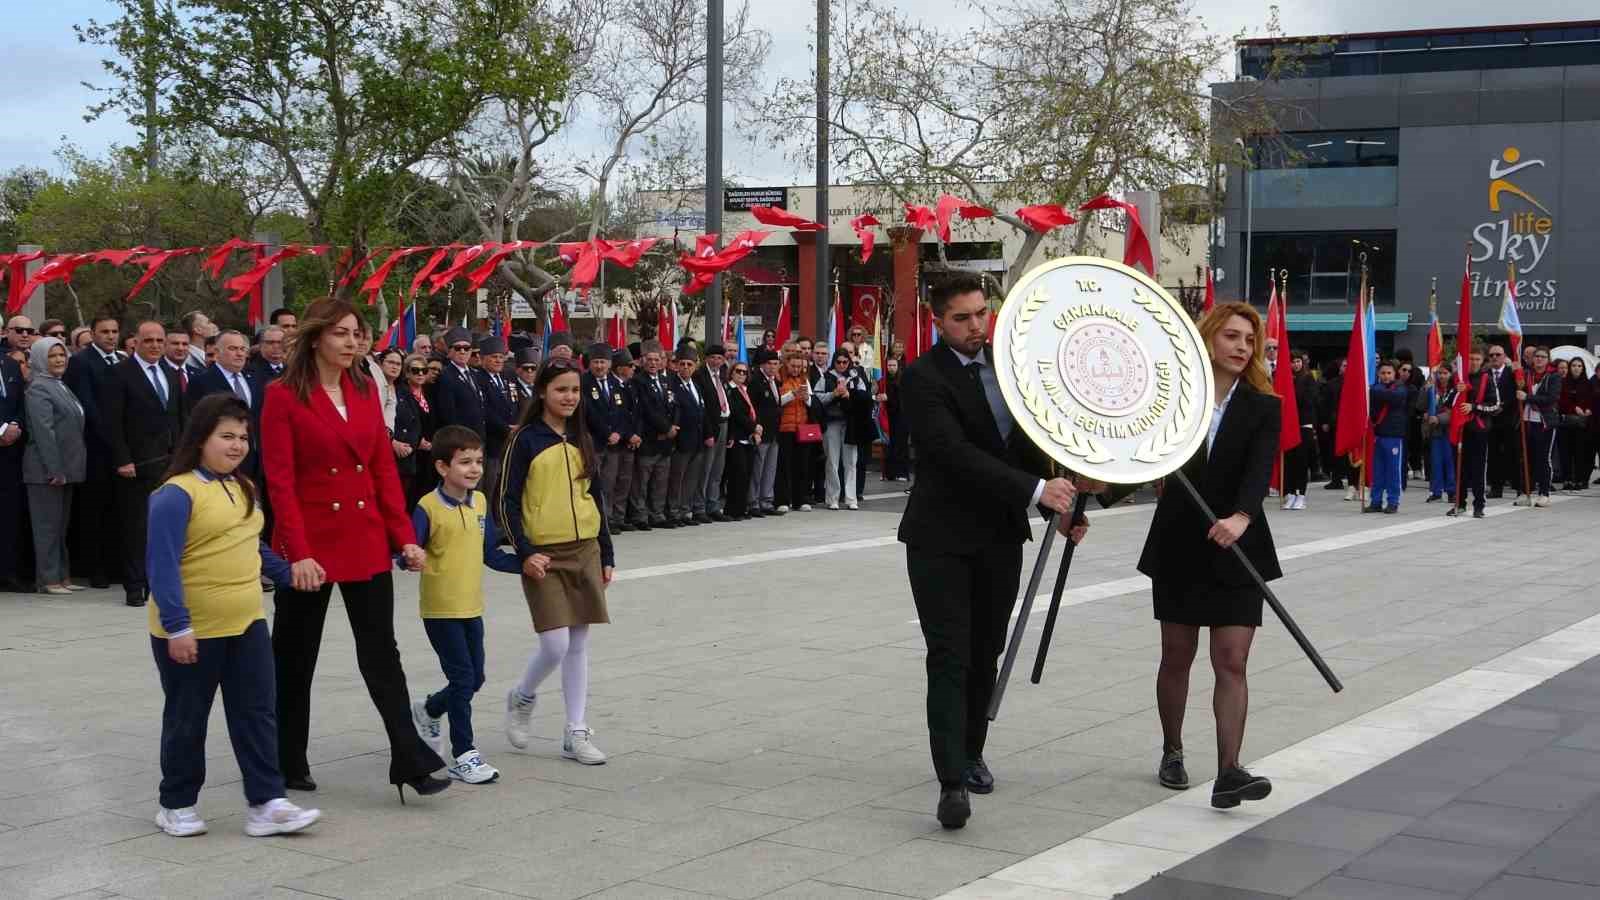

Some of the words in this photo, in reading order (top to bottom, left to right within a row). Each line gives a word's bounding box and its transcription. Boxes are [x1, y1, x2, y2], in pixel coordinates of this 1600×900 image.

[1512, 213, 1552, 234] life
[1471, 219, 1550, 274] Sky
[1516, 298, 1556, 310] world
